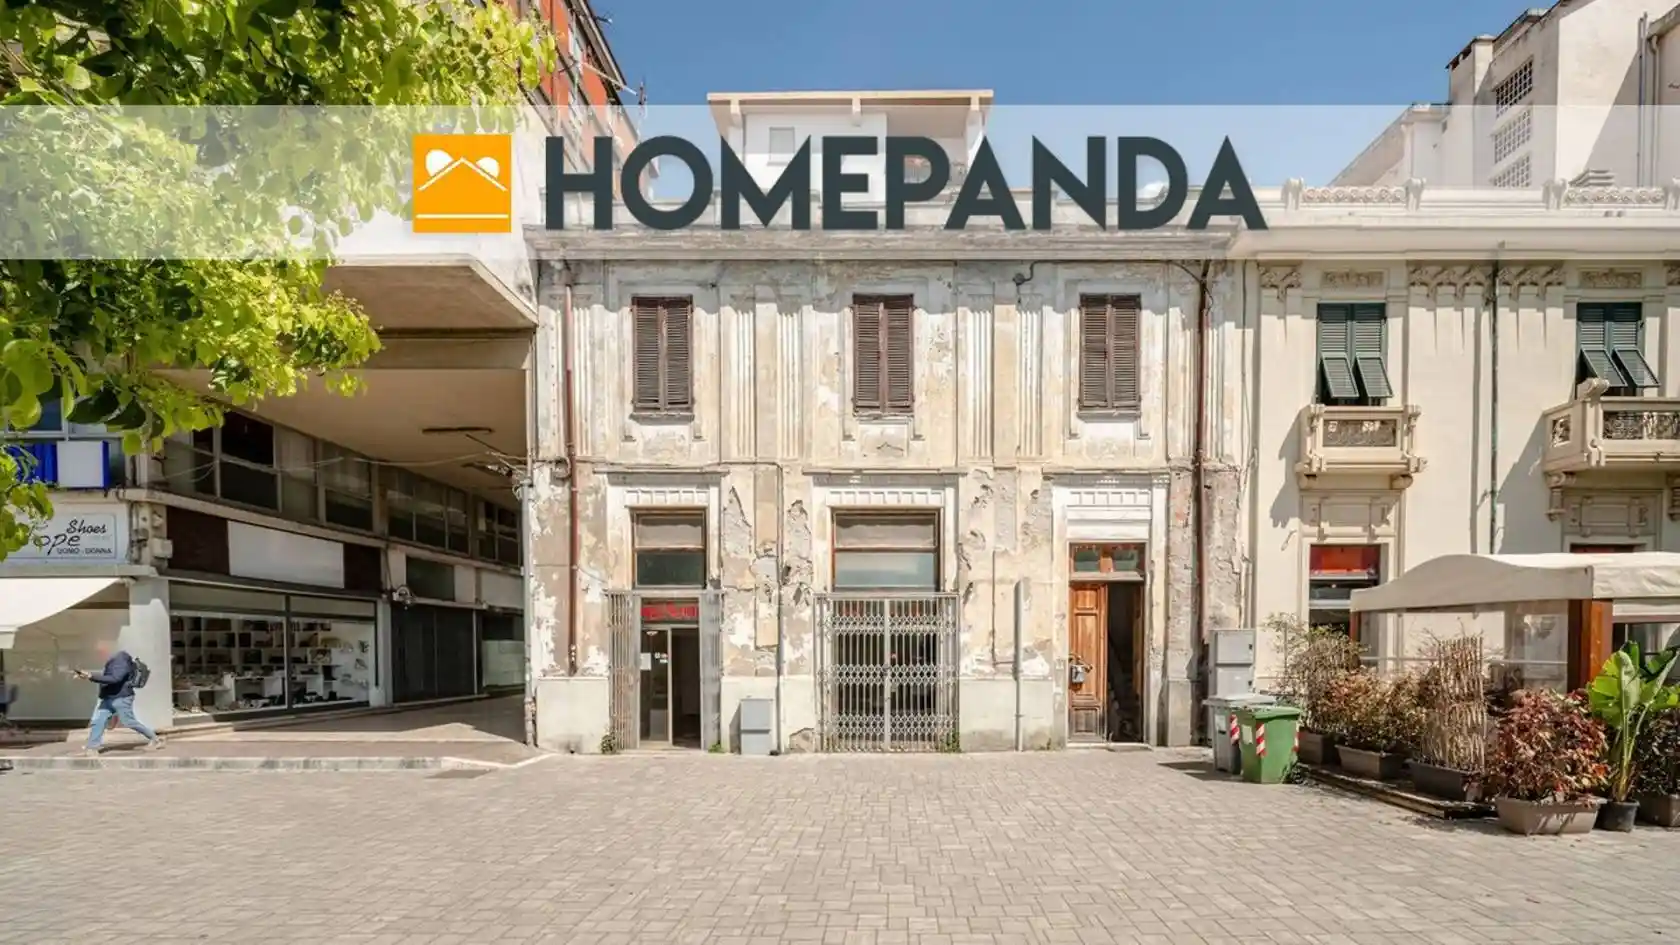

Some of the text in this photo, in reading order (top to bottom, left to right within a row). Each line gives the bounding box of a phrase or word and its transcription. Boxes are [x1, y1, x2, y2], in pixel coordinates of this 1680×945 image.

[65, 519, 107, 534] Shoes
[56, 547, 113, 555] UOMO DONNA
